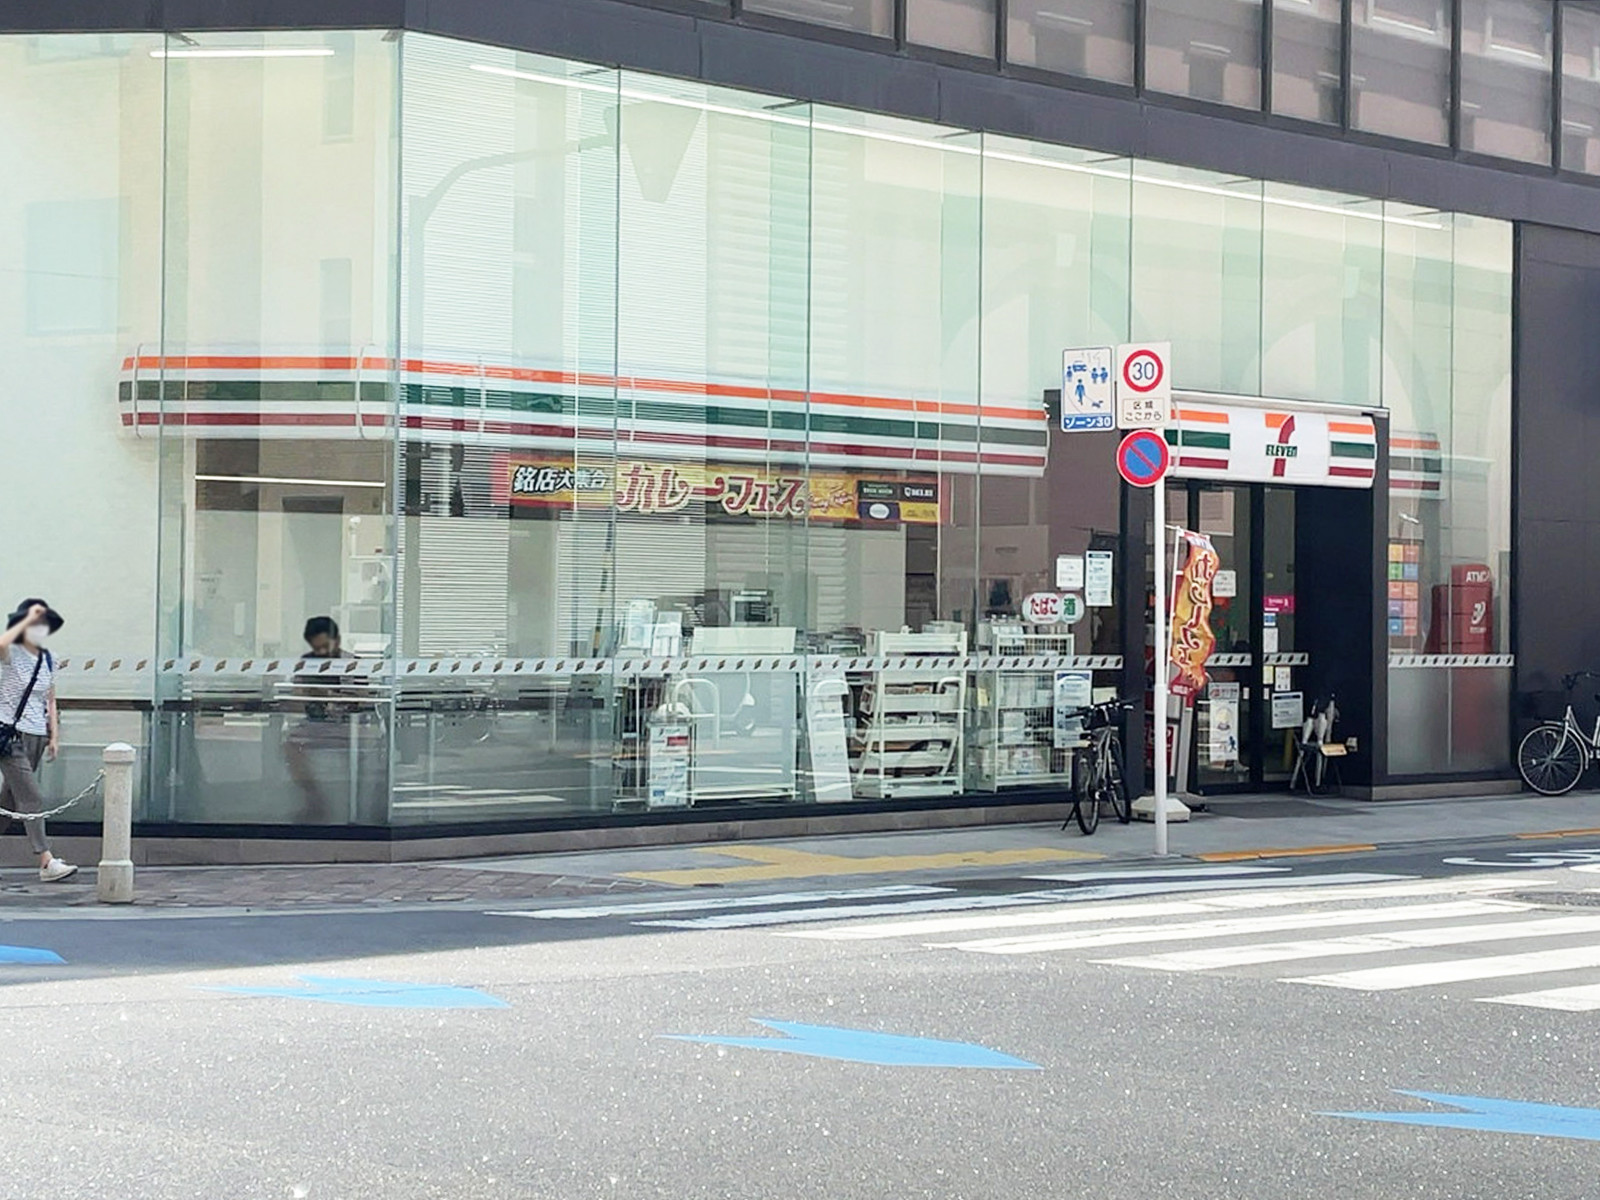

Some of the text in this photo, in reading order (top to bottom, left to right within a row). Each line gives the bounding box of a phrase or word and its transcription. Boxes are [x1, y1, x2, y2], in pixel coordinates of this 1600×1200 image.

[1131, 361, 1155, 381] 30
[1125, 411, 1162, 421] ここから
[1264, 412, 1296, 477] 7
[513, 465, 608, 493] 銘店大集合
[614, 462, 806, 519] カレーフェス
[1030, 597, 1077, 616] たばこ 酒
